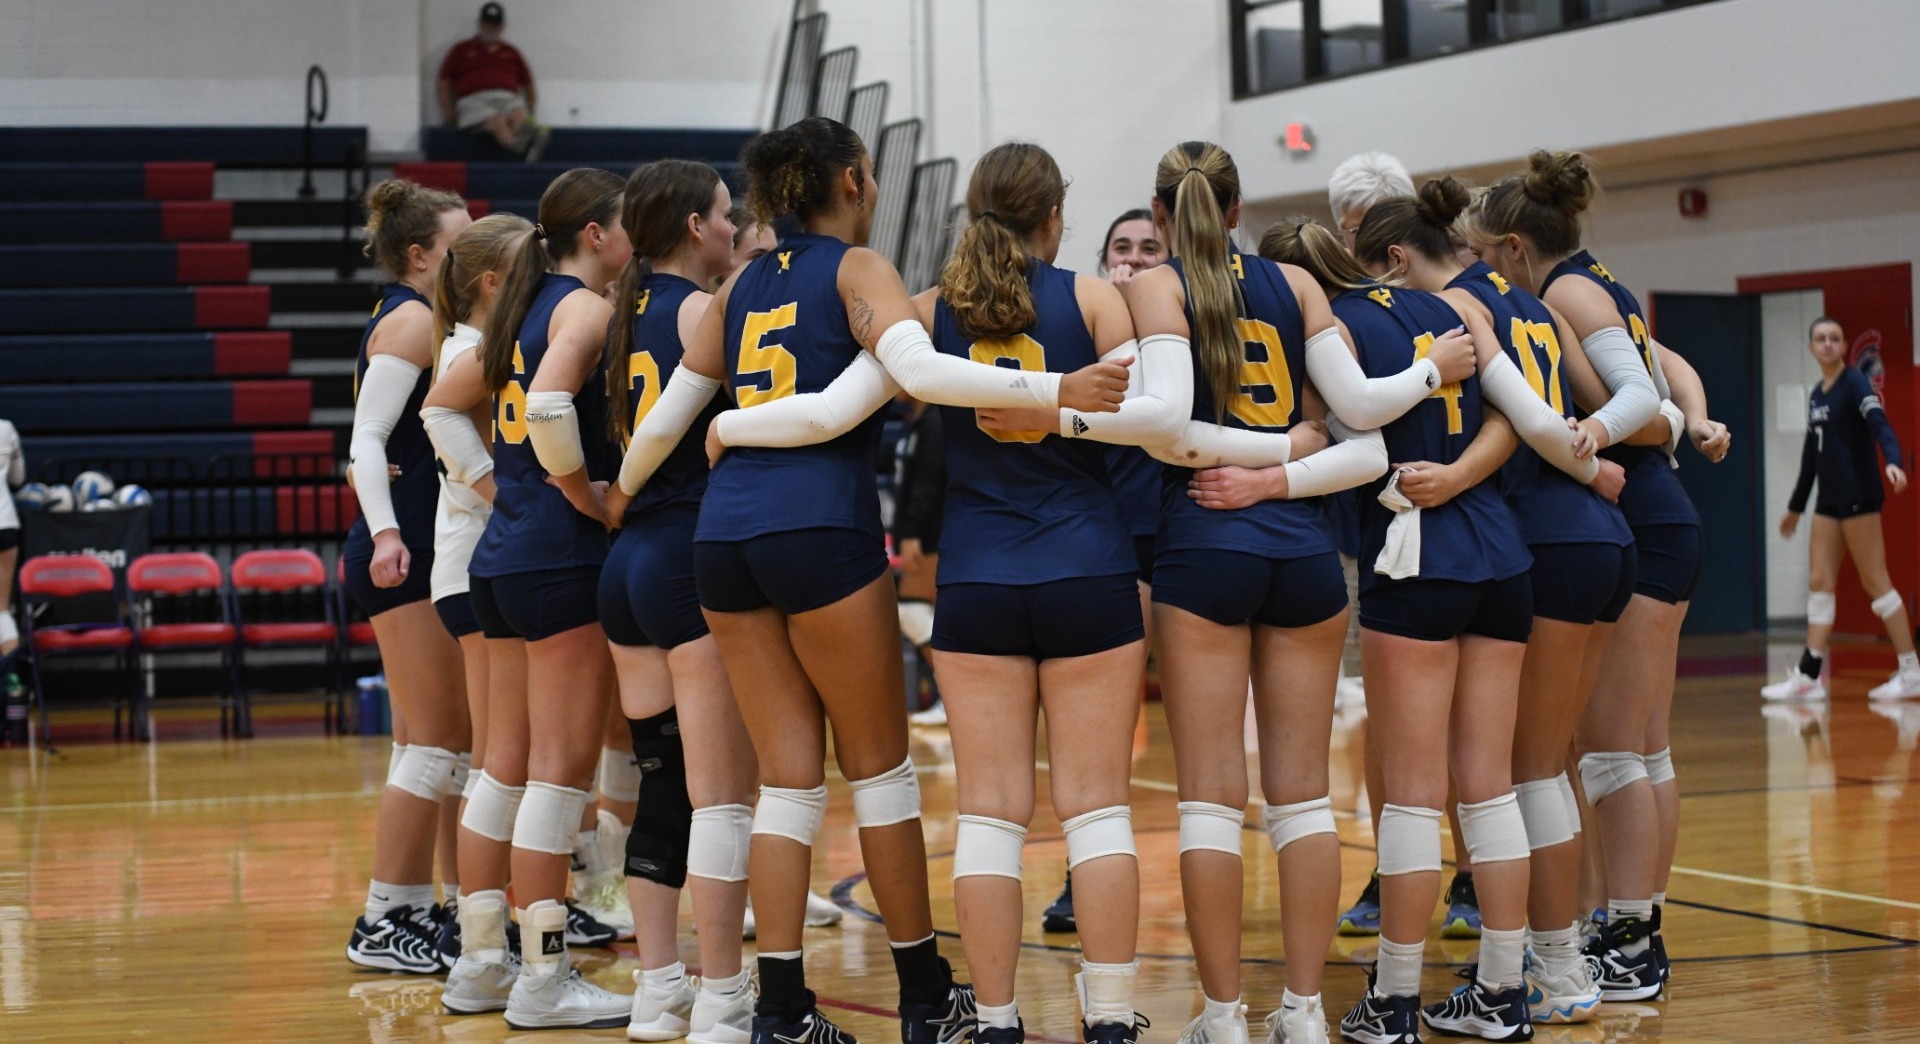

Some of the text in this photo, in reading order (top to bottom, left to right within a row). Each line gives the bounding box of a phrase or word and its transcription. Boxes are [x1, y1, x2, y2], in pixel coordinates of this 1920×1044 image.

[735, 301, 797, 410] 5
[1227, 317, 1294, 427] 9
[1413, 331, 1463, 435] 4
[1511, 316, 1564, 416] 17
